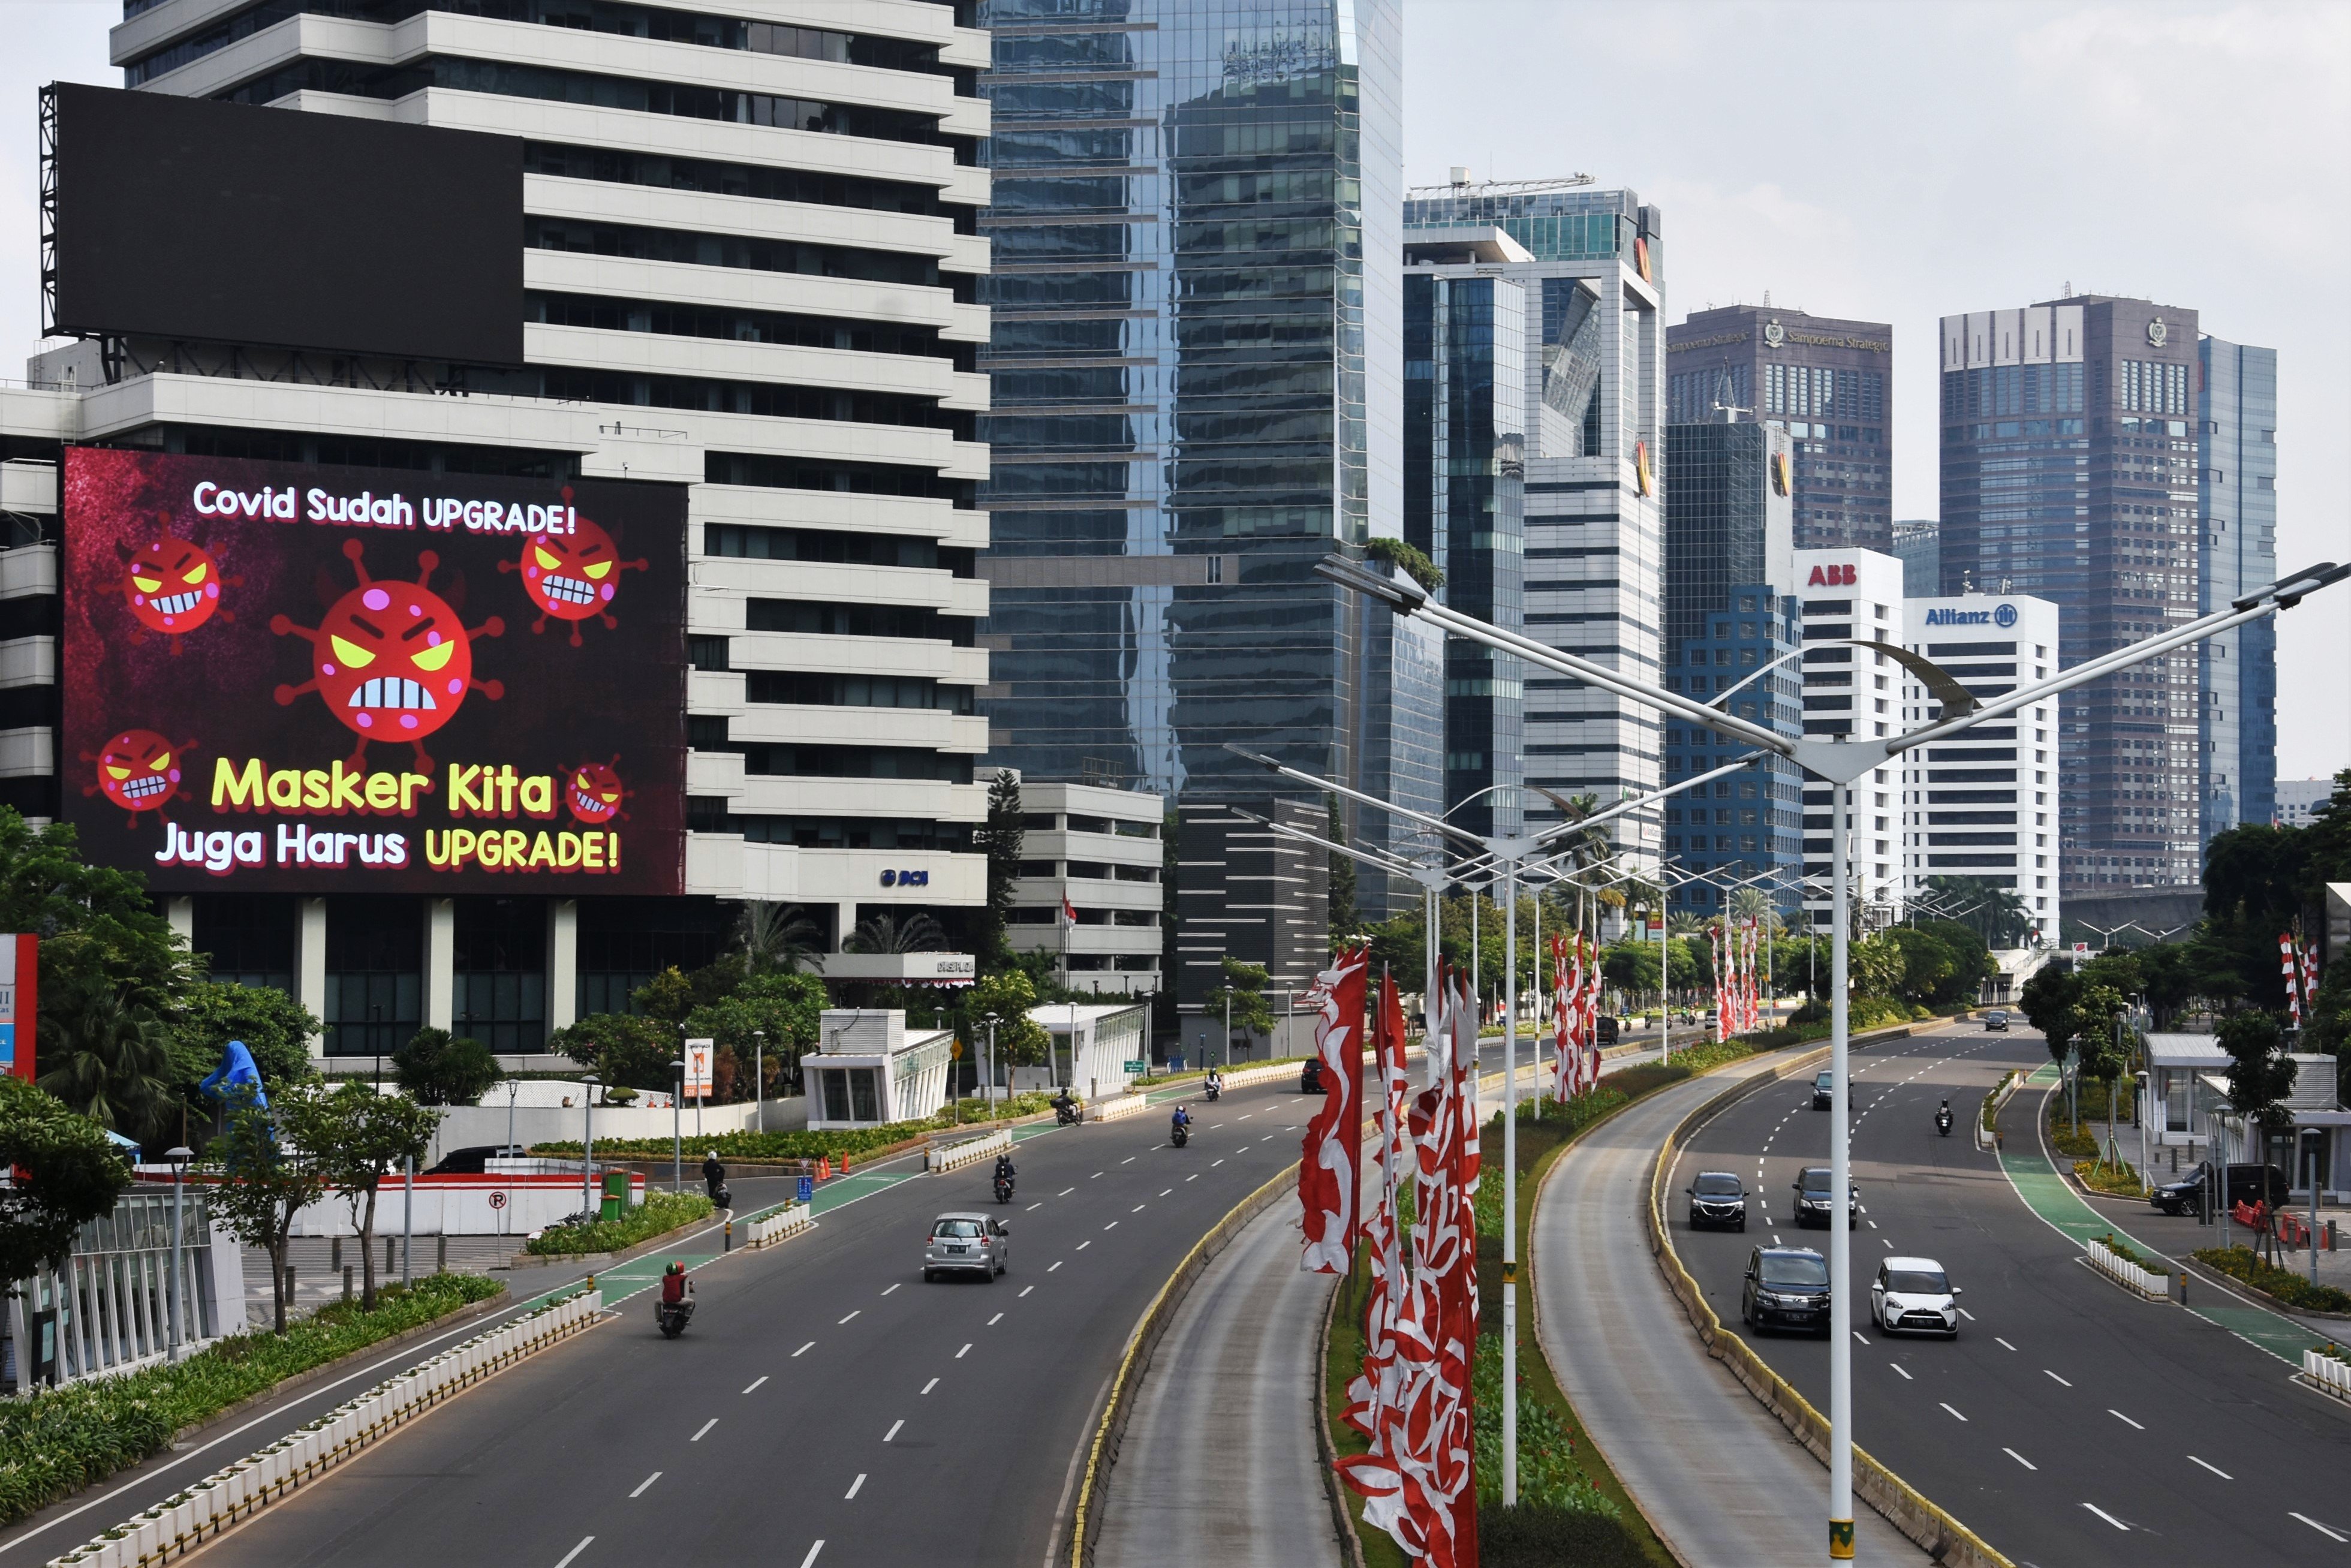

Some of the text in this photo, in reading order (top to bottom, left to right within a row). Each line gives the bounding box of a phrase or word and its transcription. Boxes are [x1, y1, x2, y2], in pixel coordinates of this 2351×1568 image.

[1788, 330, 1889, 354] Sampoerna Strategic
[193, 481, 576, 535] Covid Sudah UPGRADE!
[1808, 564, 1857, 586] ABB
[1926, 609, 1989, 625] Allianz
[211, 759, 552, 813] Masker Kita
[154, 822, 619, 871] Juga Harus UPGRADE!
[898, 870, 929, 886] BCA
